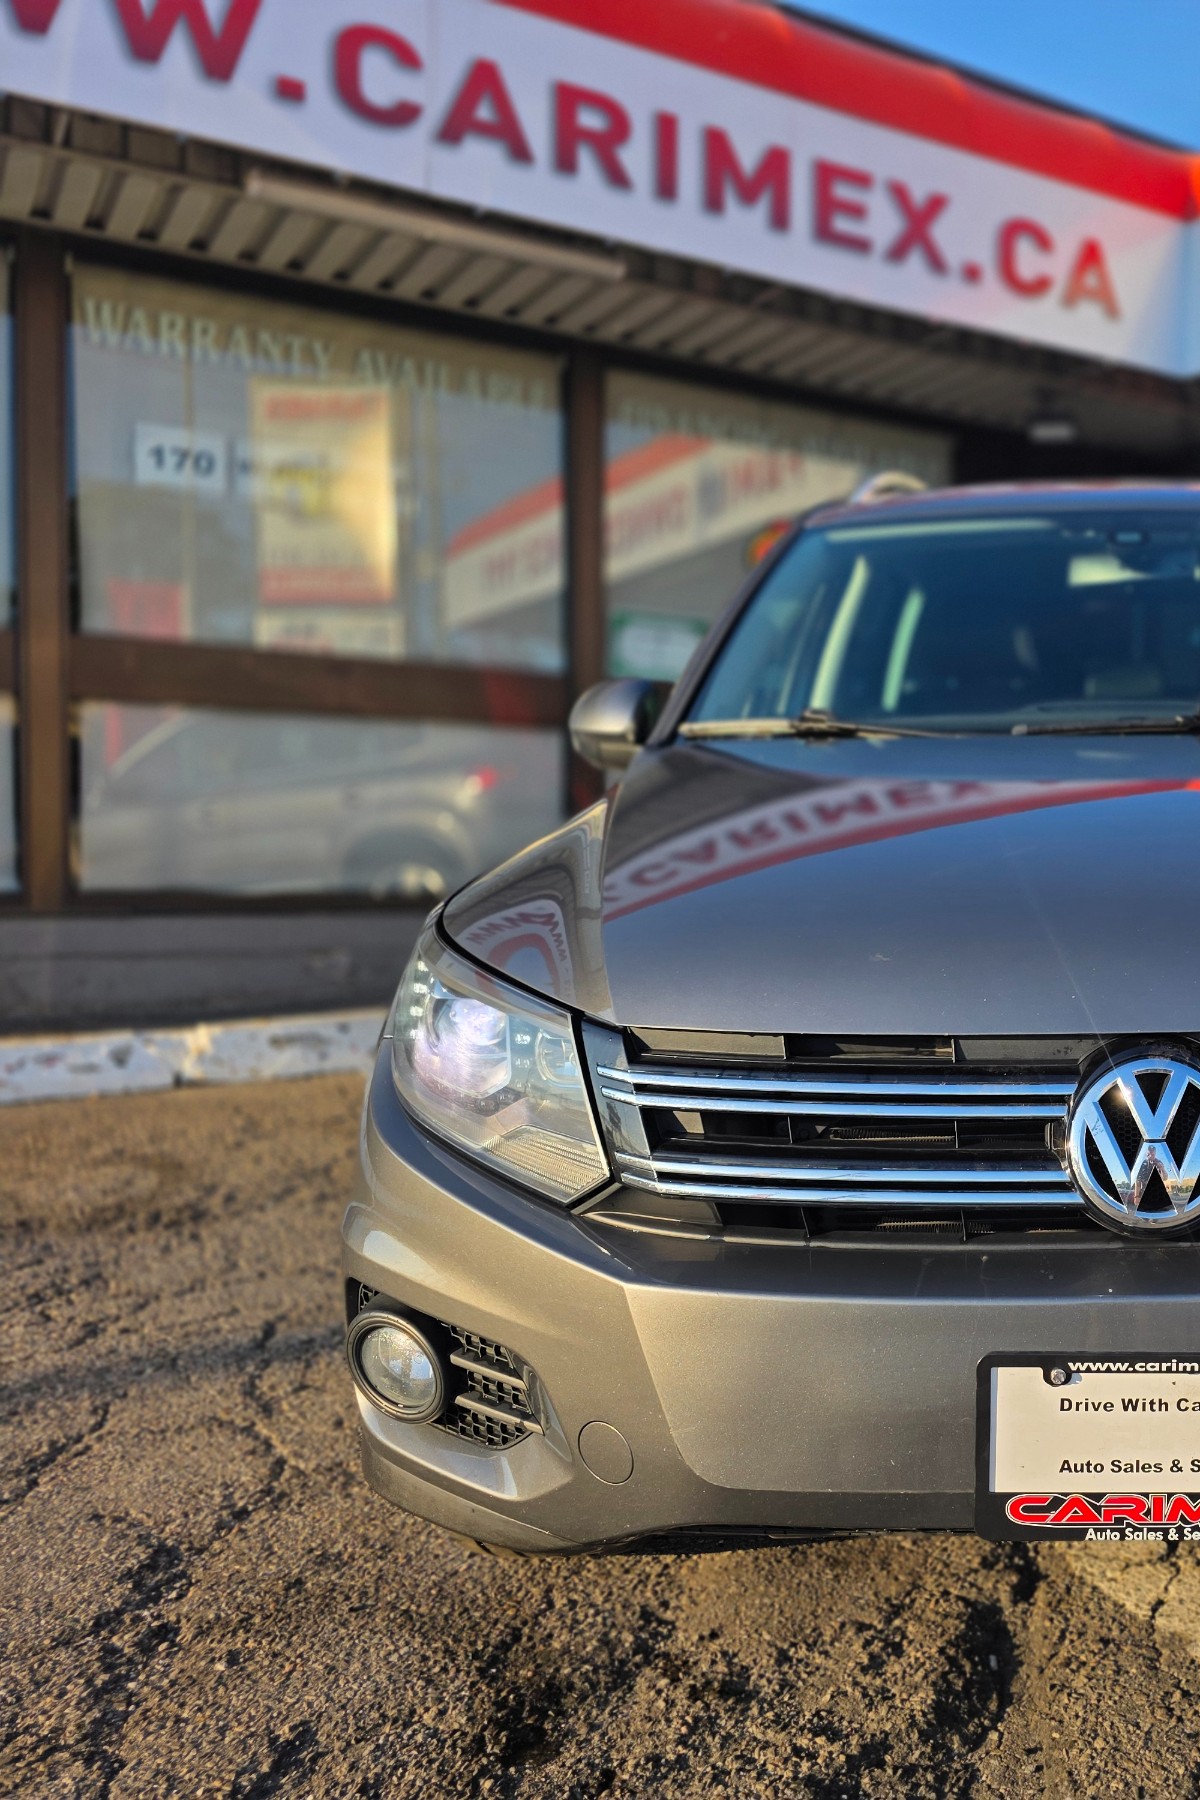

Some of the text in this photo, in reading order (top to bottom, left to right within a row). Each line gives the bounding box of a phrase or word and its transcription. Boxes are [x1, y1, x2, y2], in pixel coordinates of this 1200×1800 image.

[82, 298, 337, 381] WARRANTY
[1058, 1397, 1115, 1413] Drive
[1120, 1397, 1170, 1413] With
[1058, 1459, 1105, 1474] Auto
[1110, 1459, 1164, 1474] Sales
[1169, 1459, 1184, 1474] &
[1085, 1527, 1121, 1541] Auto
[1124, 1527, 1164, 1541] Sales
[1167, 1527, 1179, 1541] &
